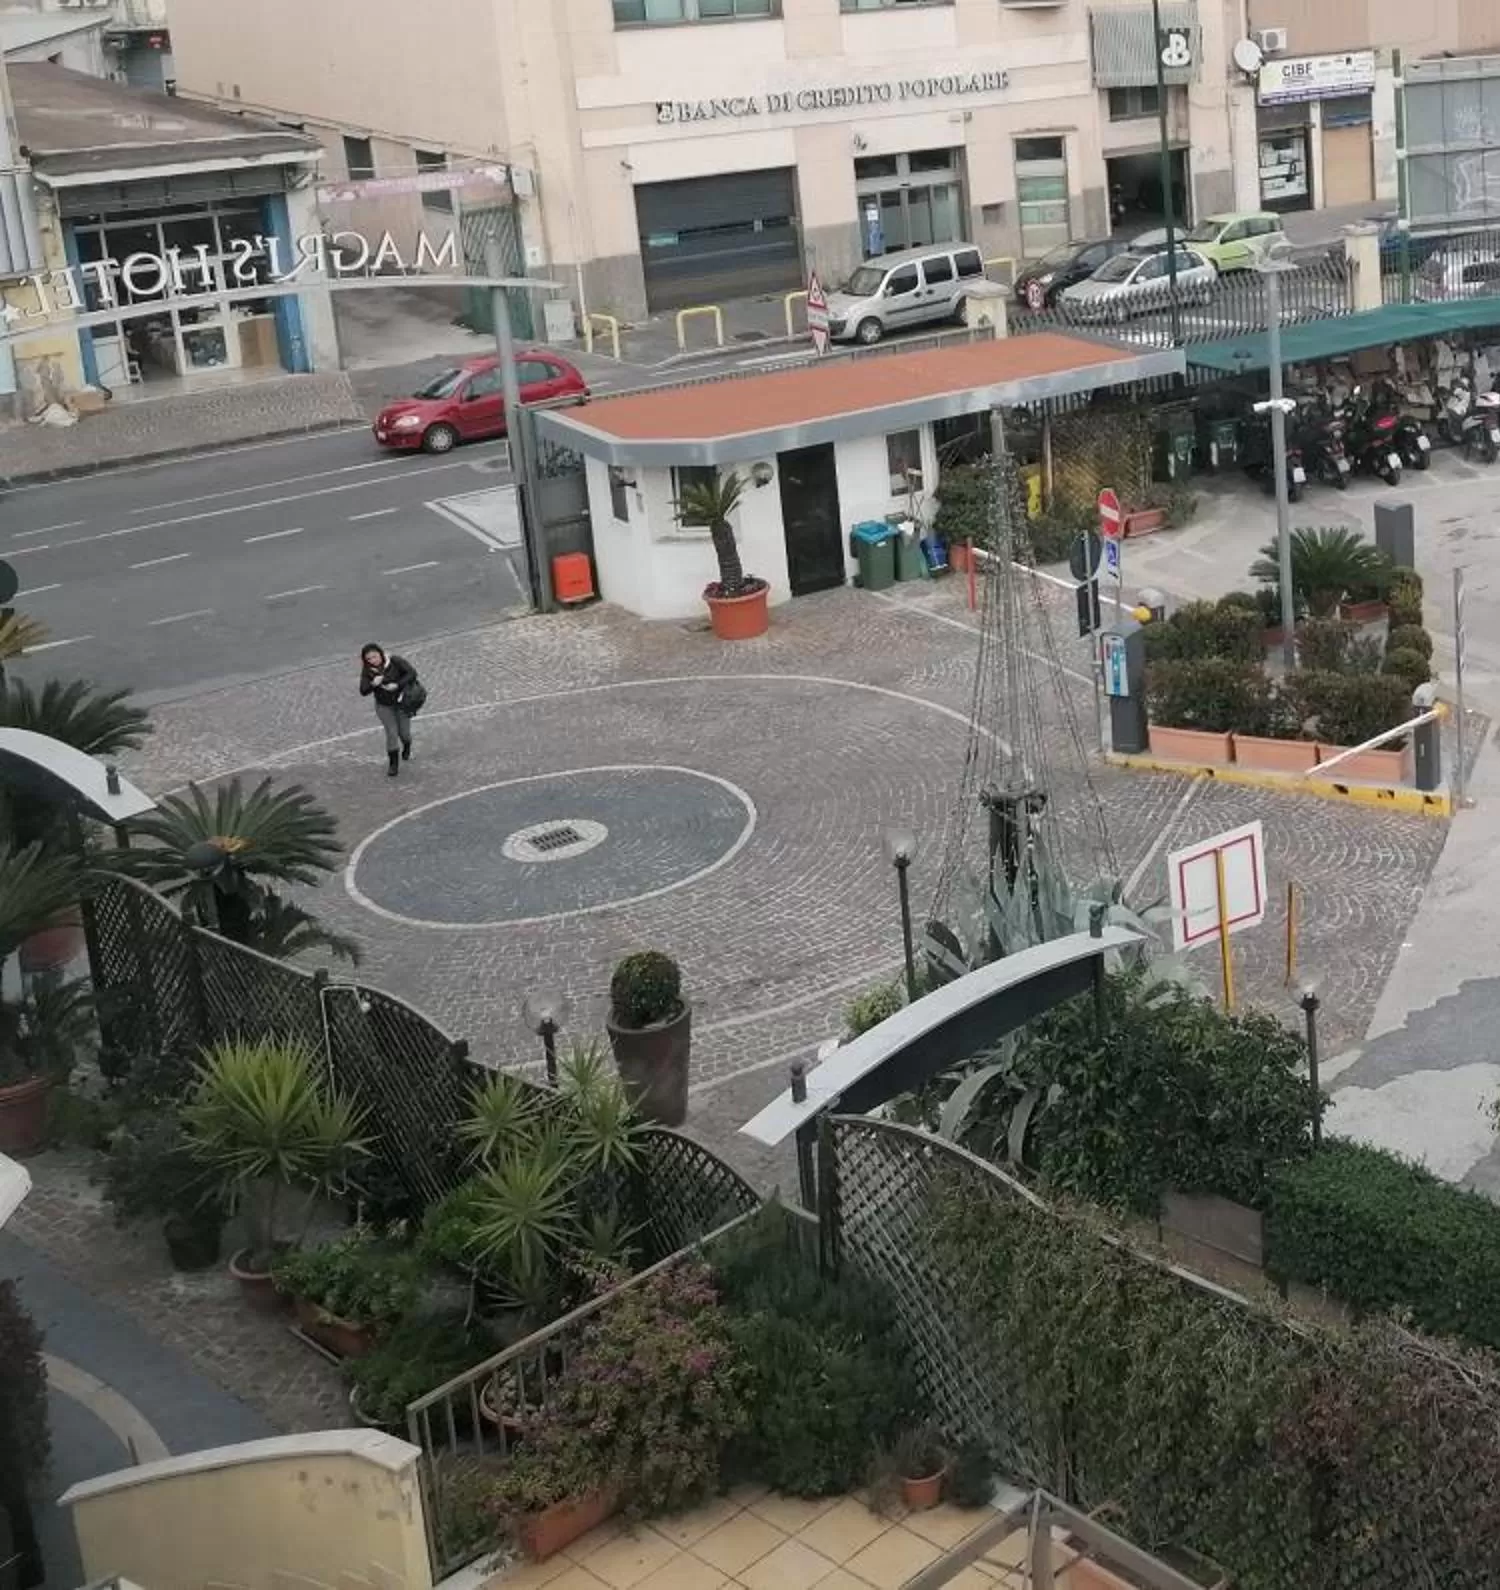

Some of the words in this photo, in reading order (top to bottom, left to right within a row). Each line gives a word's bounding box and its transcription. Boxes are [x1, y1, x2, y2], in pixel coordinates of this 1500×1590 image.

[677, 97, 760, 122] BANCA
[766, 92, 792, 113] DI
[797, 81, 891, 111] CREDITO
[899, 71, 1009, 100] POPOLARE
